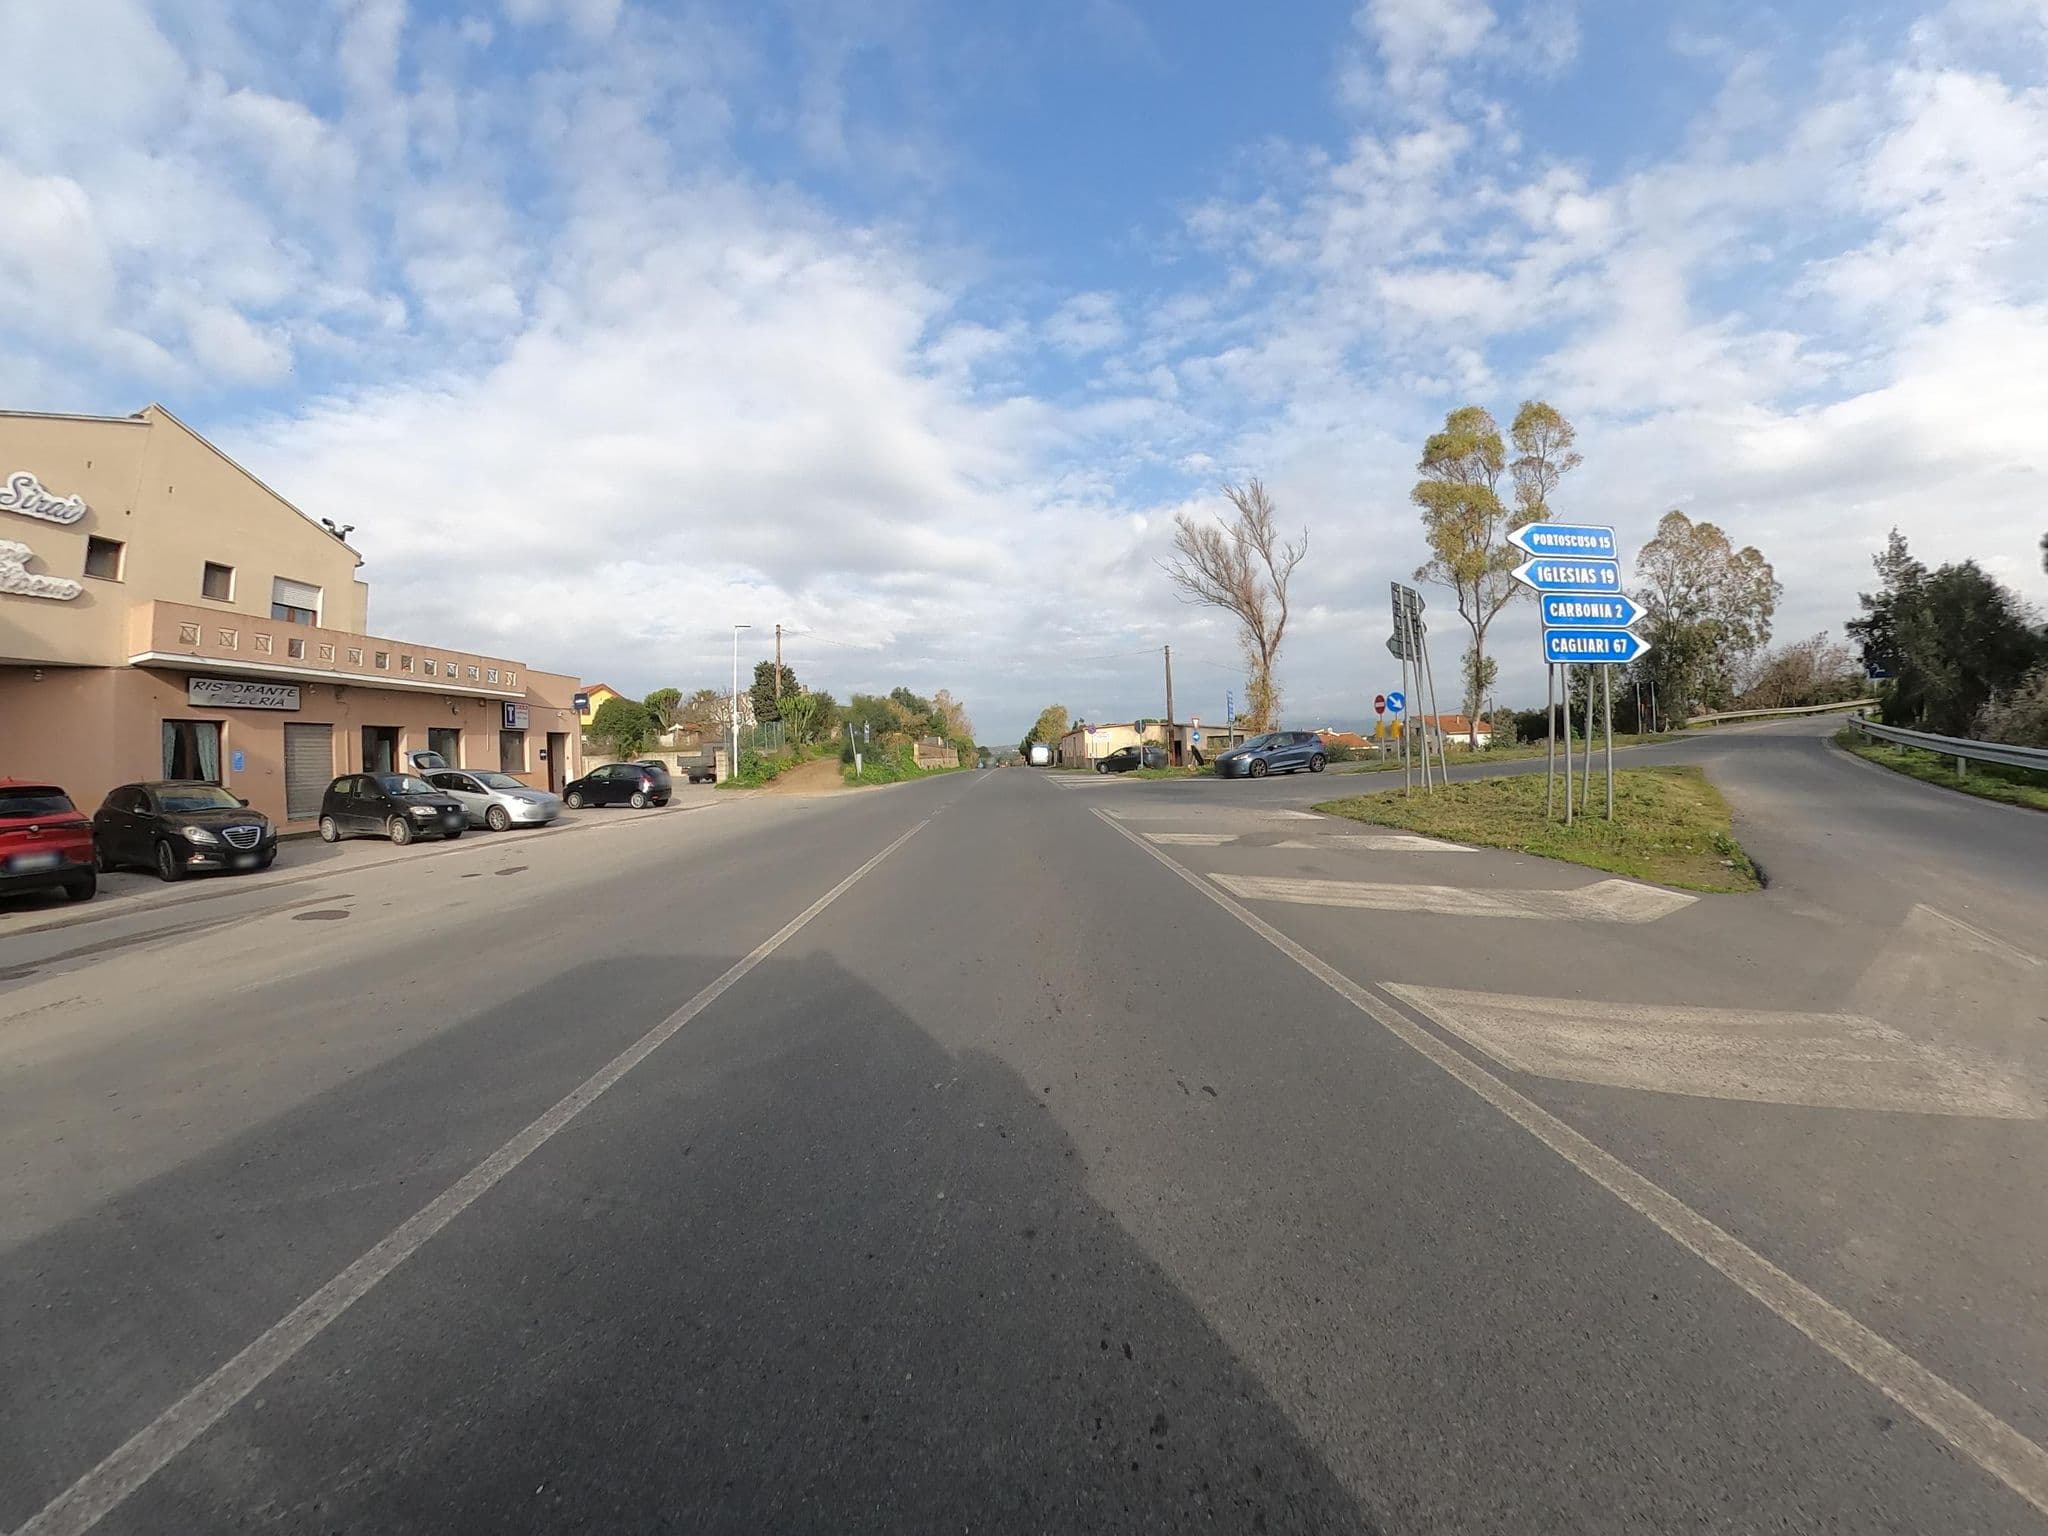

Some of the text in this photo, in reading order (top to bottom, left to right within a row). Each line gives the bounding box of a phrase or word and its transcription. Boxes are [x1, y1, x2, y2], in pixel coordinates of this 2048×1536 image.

[1533, 534, 1611, 548] PORTOSCUSO 15
[1537, 566, 1615, 585] IGLESIAS 19
[1549, 602, 1623, 619] CARBONIA 2
[1551, 638, 1627, 654] CAGLIARI 67
[193, 681, 297, 698] RISTORANTE
